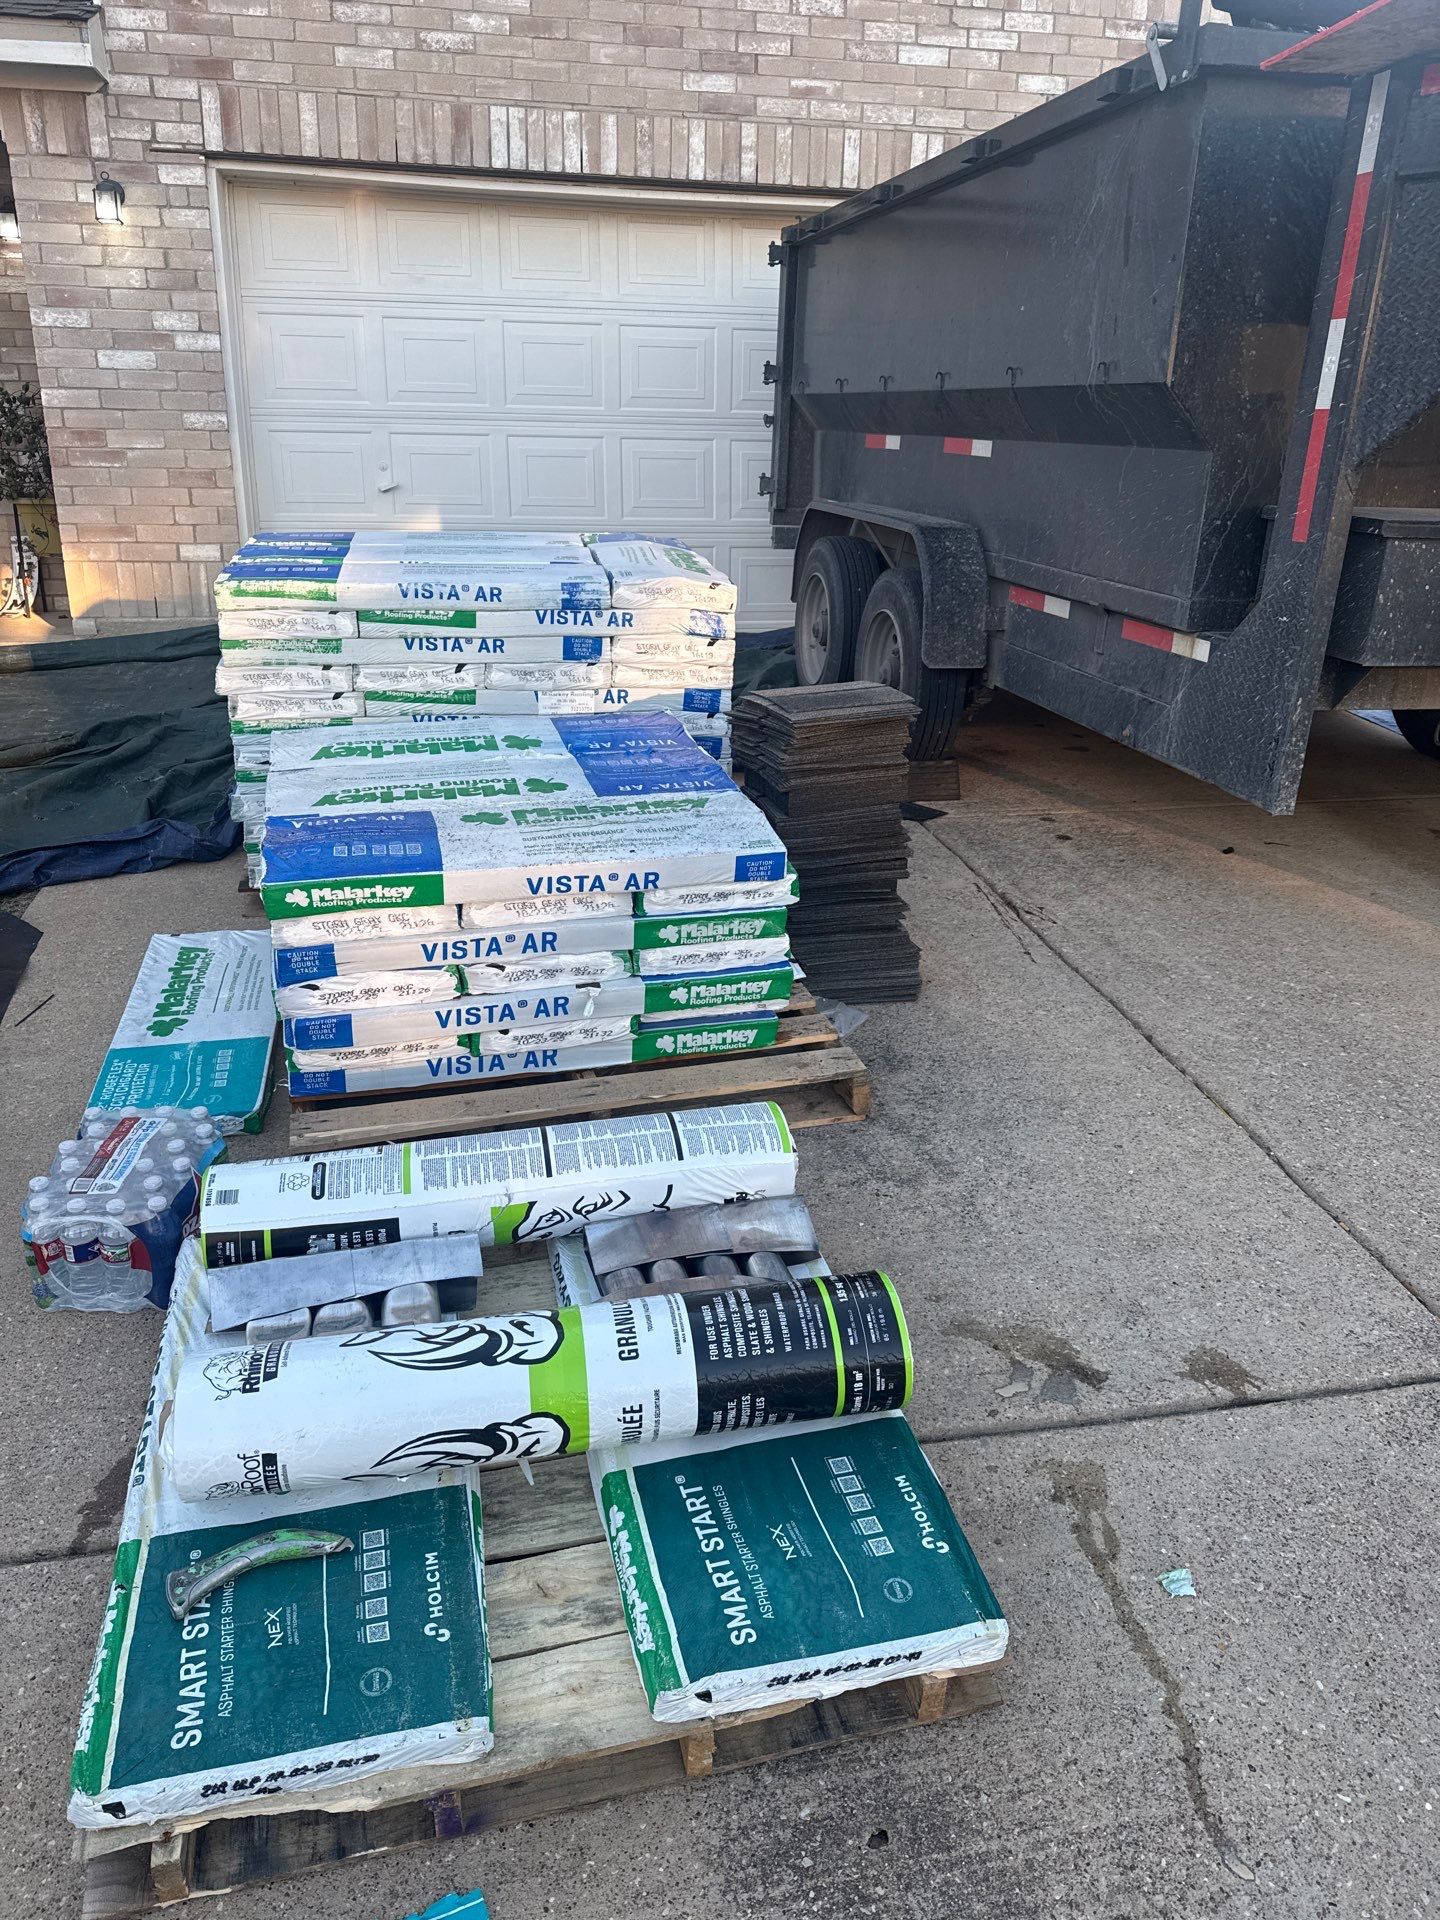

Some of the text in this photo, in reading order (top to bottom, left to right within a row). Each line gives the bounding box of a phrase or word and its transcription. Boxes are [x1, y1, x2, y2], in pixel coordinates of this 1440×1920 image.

[474, 586, 502, 603] AR
[384, 611, 451, 621] Roofing Products
[536, 609, 634, 628] VISTA® AR
[403, 637, 505, 654] VISTA® AR
[603, 688, 629, 704] AR
[310, 739, 500, 760] Malarkey
[335, 734, 496, 746] Roofing Products
[311, 783, 521, 807] Malarkey
[341, 777, 517, 794] Roofing Products
[618, 784, 643, 792] AR
[511, 797, 710, 821] Malarkey
[311, 884, 415, 902] Malarkey
[526, 872, 660, 895] VISTA® AR
[312, 897, 403, 909] Roofing Products
[681, 918, 766, 939] Malarkey
[421, 931, 557, 962] VISTA® AR
[680, 935, 714, 945] Roofing
[291, 960, 320, 969] DOUBLE
[574, 968, 606, 977] 21:27
[153, 946, 210, 1018] Malarkey
[180, 951, 216, 1016] Roofing Products
[399, 986, 431, 997] 21:26
[690, 980, 773, 999] Malarkey
[318, 990, 355, 1001] STORM
[359, 986, 388, 996] GRAY
[690, 996, 722, 1006] Roofing
[435, 996, 570, 1029] VISTA® AR
[311, 1033, 335, 1041] STACK
[513, 1032, 545, 1041] STORM
[549, 1029, 575, 1038] GRAY
[582, 1030, 614, 1039] 21:32
[677, 1028, 758, 1048] Malarkey
[676, 1042, 747, 1055] Roofing Products
[426, 1049, 558, 1077] VISTA® AR
[128, 1063, 151, 1104] PROTECTOR
[306, 1081, 329, 1089] STACK
[352, 1231, 361, 1244] LES
[365, 1229, 374, 1242] LES
[743, 1302, 761, 1356] SLATE & WOOD
[758, 1308, 775, 1354] & SHINGLES
[772, 1291, 793, 1352] WATERPROOF BARRIER
[701, 1304, 719, 1361] FOR USE UNDER
[719, 1323, 733, 1359] ASPHALT
[732, 1312, 748, 1357] COMPOSITE
[852, 1370, 863, 1381] m²
[853, 1382, 864, 1392] 18
[756, 1397, 765, 1409] LES
[894, 1474, 935, 1535] HOLCIM
[674, 1474, 757, 1647] SMART START®
[712, 1484, 775, 1620] ASPHALT STARTER SHINGLES
[424, 1551, 443, 1619] HOLCIM
[614, 1529, 656, 1654] Malarkey
[217, 1576, 236, 1718] ASPHALT STARTER SHING
[170, 1647, 210, 1750] SMART
